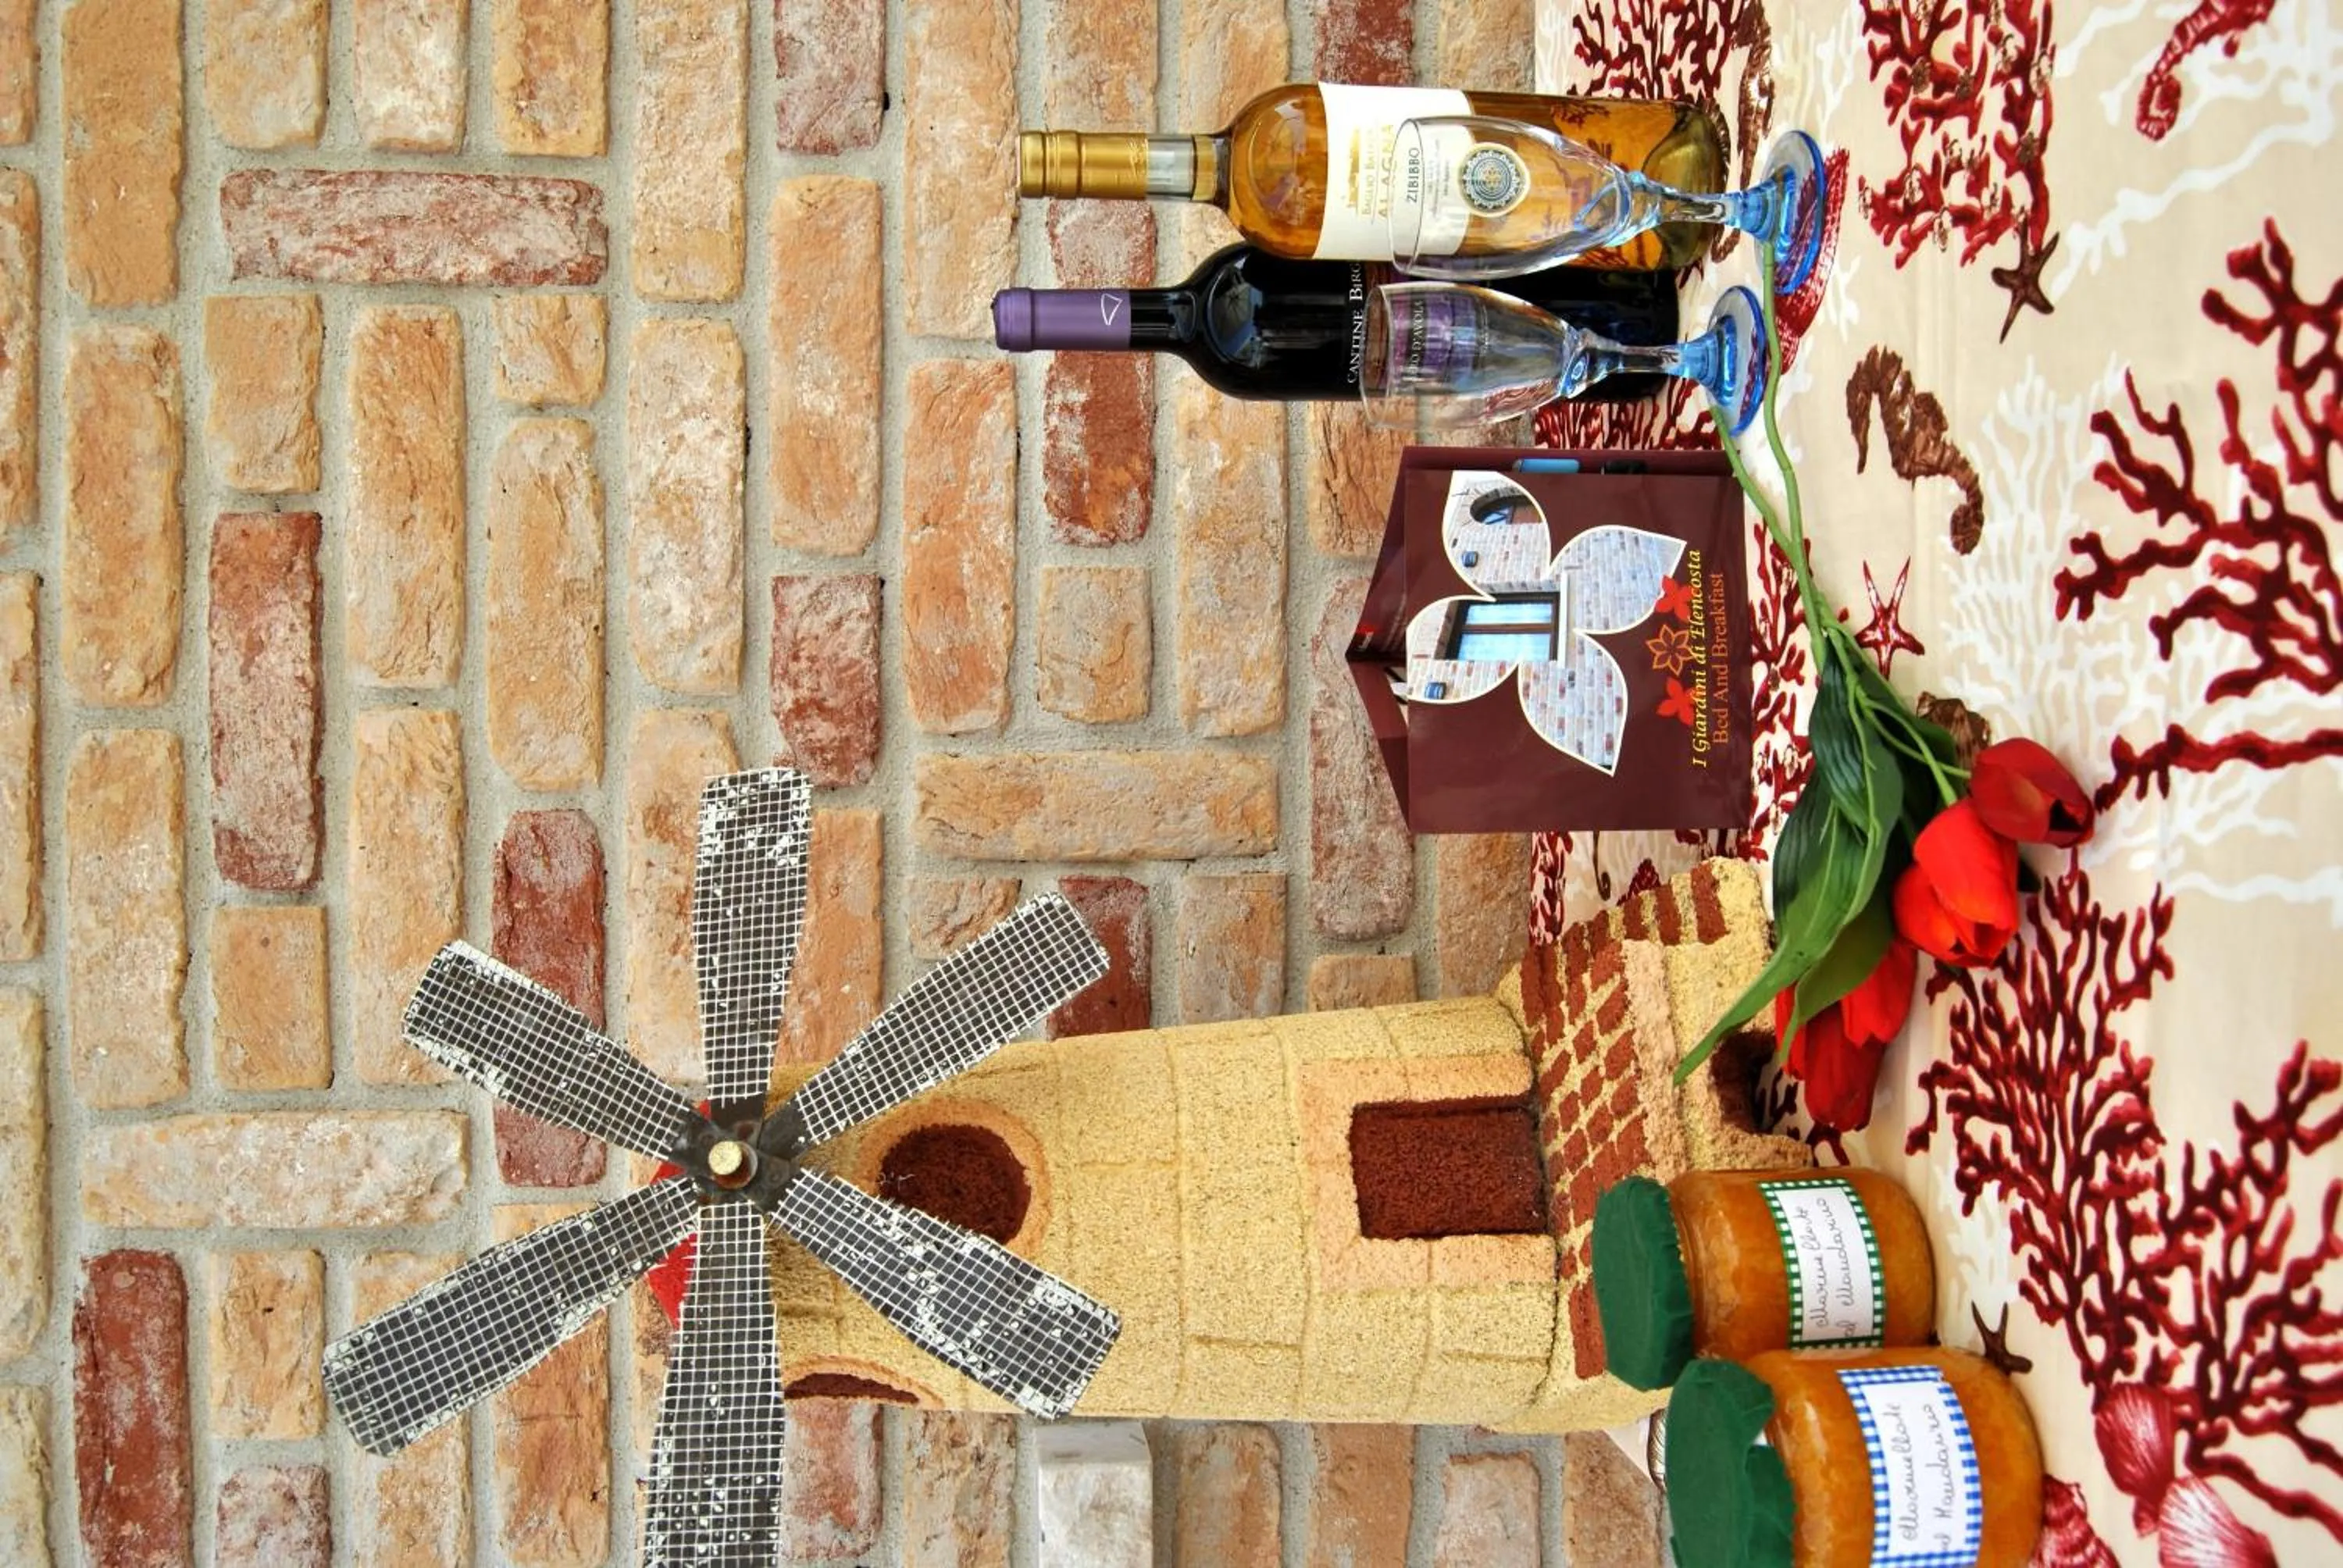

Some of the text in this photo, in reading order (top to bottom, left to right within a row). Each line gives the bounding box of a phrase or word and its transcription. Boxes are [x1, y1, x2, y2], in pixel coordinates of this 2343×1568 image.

[1406, 148, 1420, 203] ZIBIBBO
[1347, 263, 1363, 383] CANTINE BIRG
[1687, 549, 1710, 768] I Giardini di Elencosta
[1708, 572, 1728, 743] Bed And Breakfast
[1816, 1198, 1854, 1306] Mandarino
[1923, 1404, 1955, 1519] Mandarino
